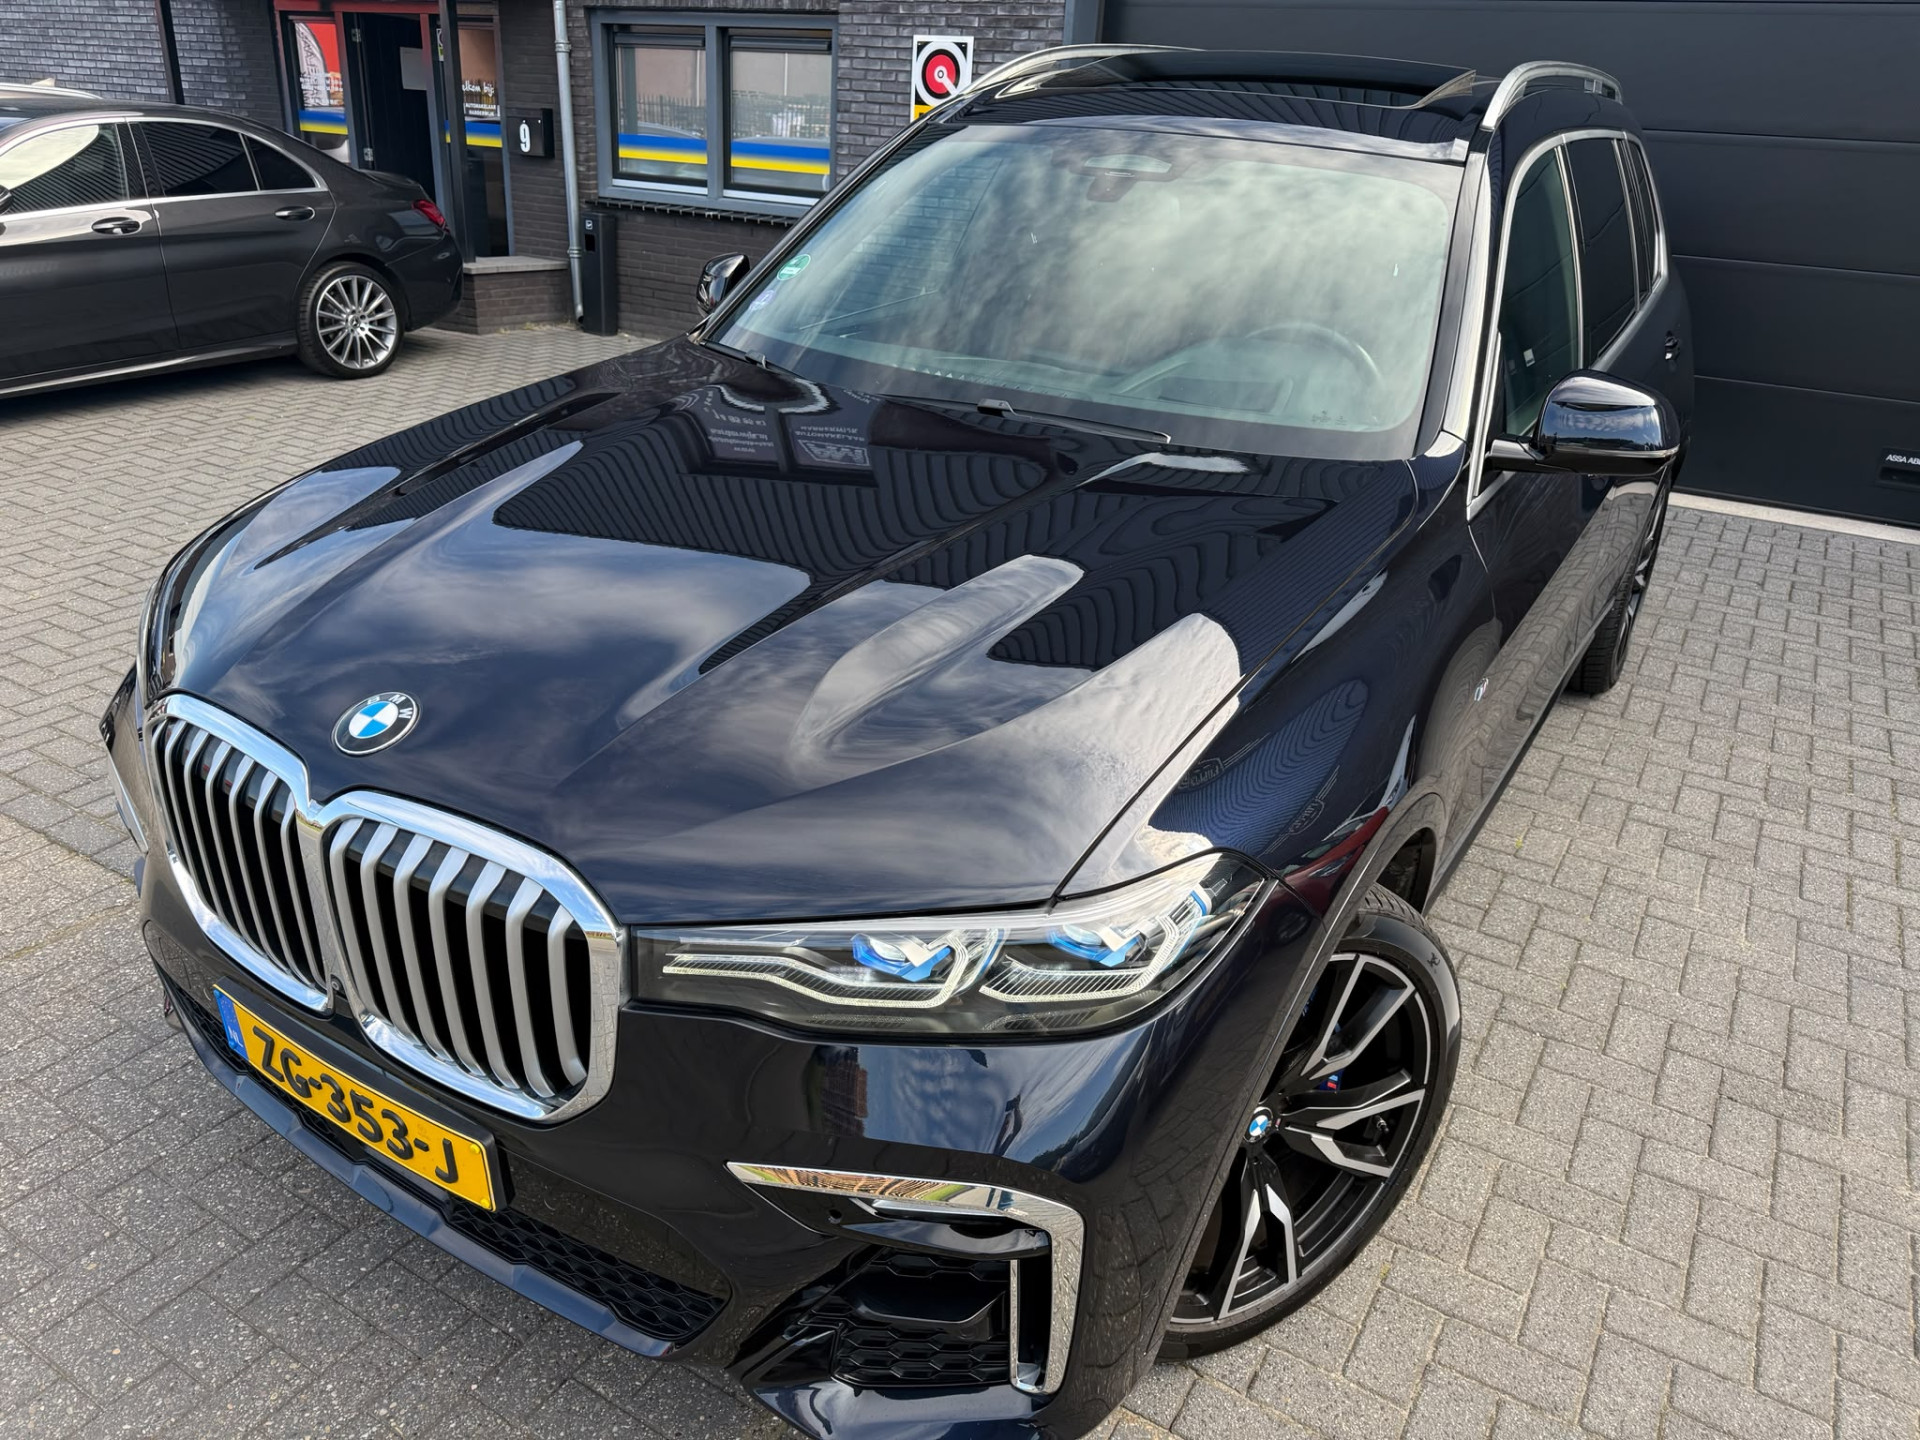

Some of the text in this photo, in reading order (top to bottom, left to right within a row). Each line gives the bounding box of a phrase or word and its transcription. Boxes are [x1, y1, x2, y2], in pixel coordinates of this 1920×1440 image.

[462, 80, 481, 92] elkom
[519, 124, 531, 153] 9
[1885, 454, 1906, 463] ASSA
[227, 1025, 244, 1048] NL
[253, 1025, 458, 1184] ZG-353-J
